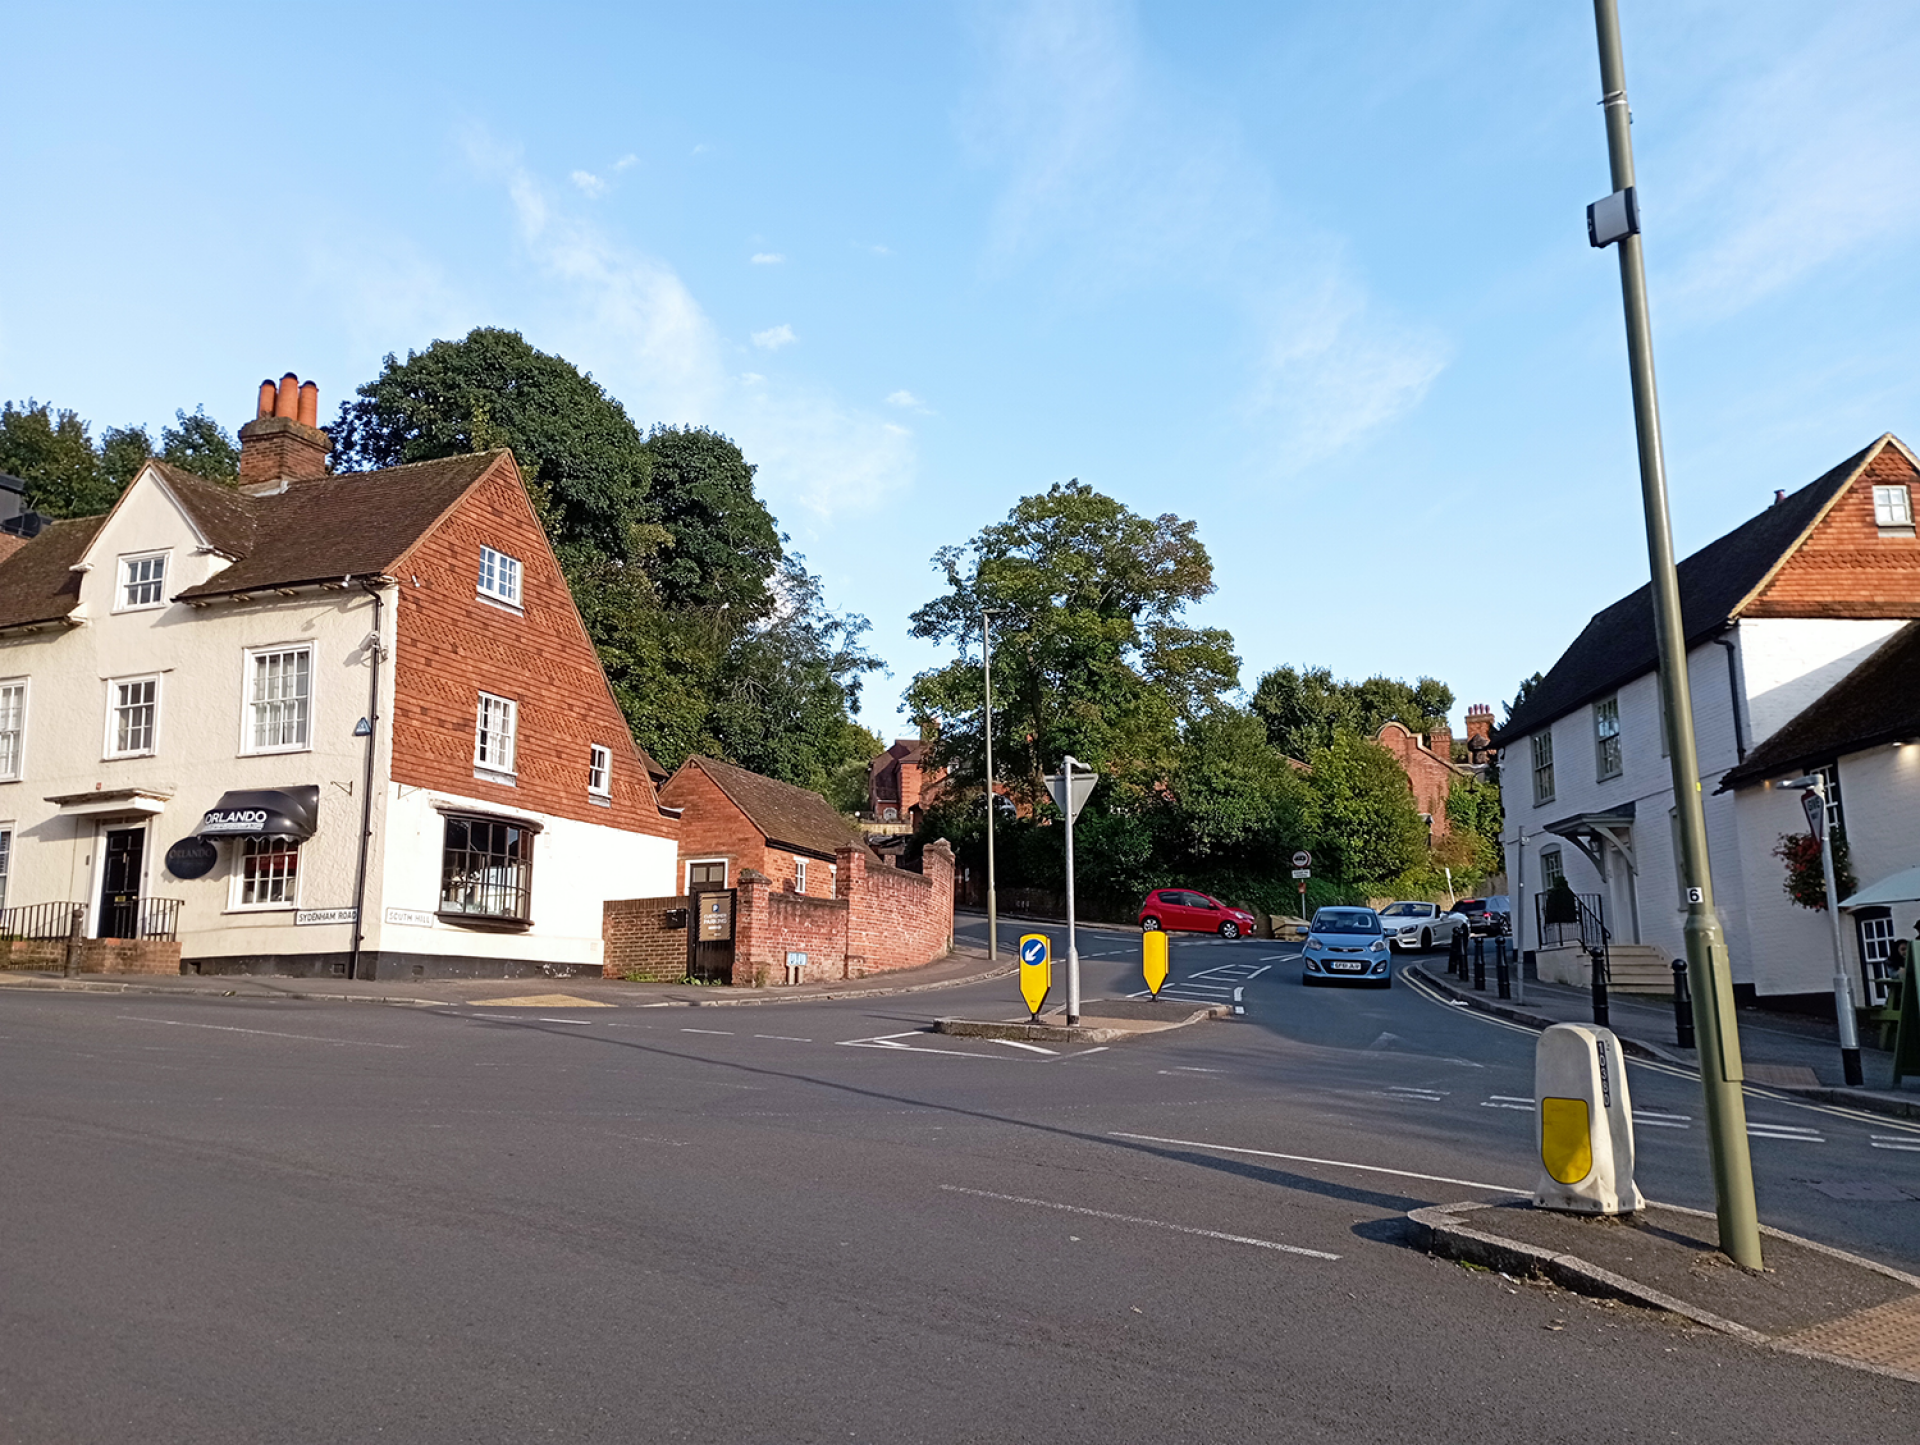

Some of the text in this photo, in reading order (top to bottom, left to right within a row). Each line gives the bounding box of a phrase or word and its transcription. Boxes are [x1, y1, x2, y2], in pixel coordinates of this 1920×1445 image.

[205, 810, 267, 824] ORLANDO
[168, 847, 212, 860] ORLANDO
[1690, 889, 1700, 902] 6
[298, 910, 358, 923] SYDENHAM ROAD
[389, 911, 430, 924] SOUTH HILL
